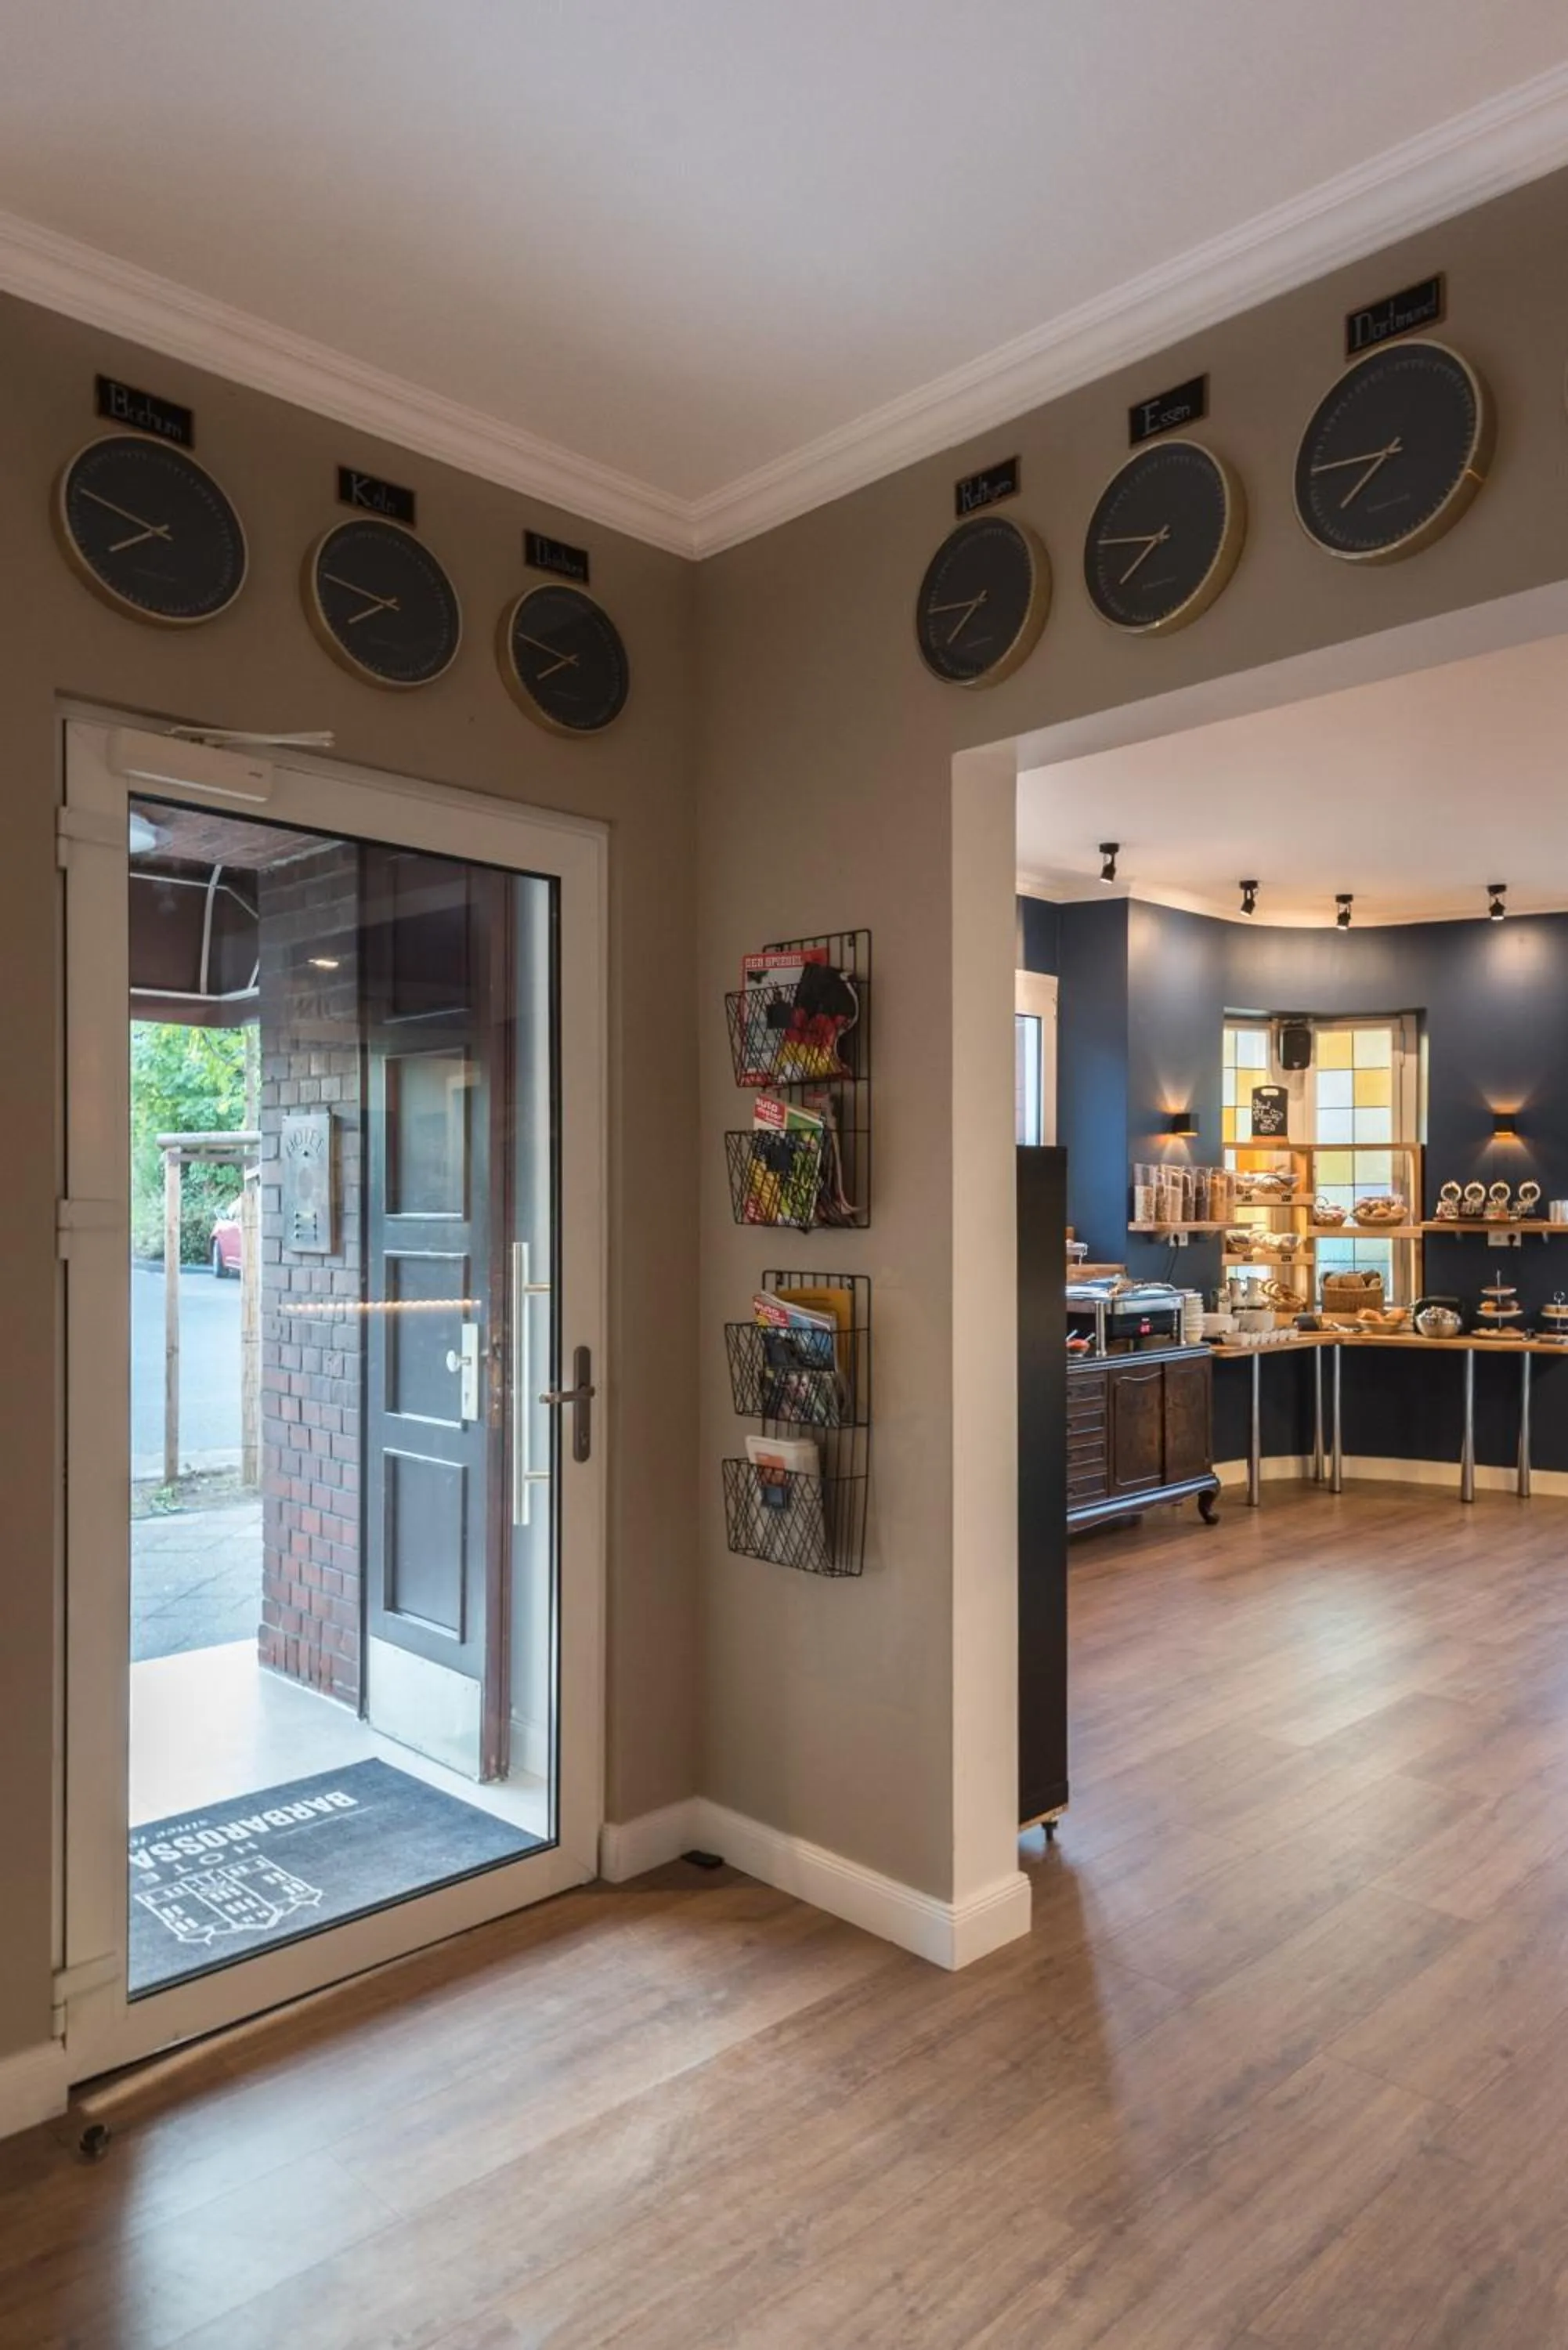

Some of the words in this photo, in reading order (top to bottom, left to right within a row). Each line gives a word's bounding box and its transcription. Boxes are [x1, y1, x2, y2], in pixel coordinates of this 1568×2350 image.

[109, 382, 182, 442] Bochum
[1140, 400, 1190, 437] Essen
[286, 1126, 325, 1159] HOTEL
[128, 1791, 359, 1870] BARBAROSSA
